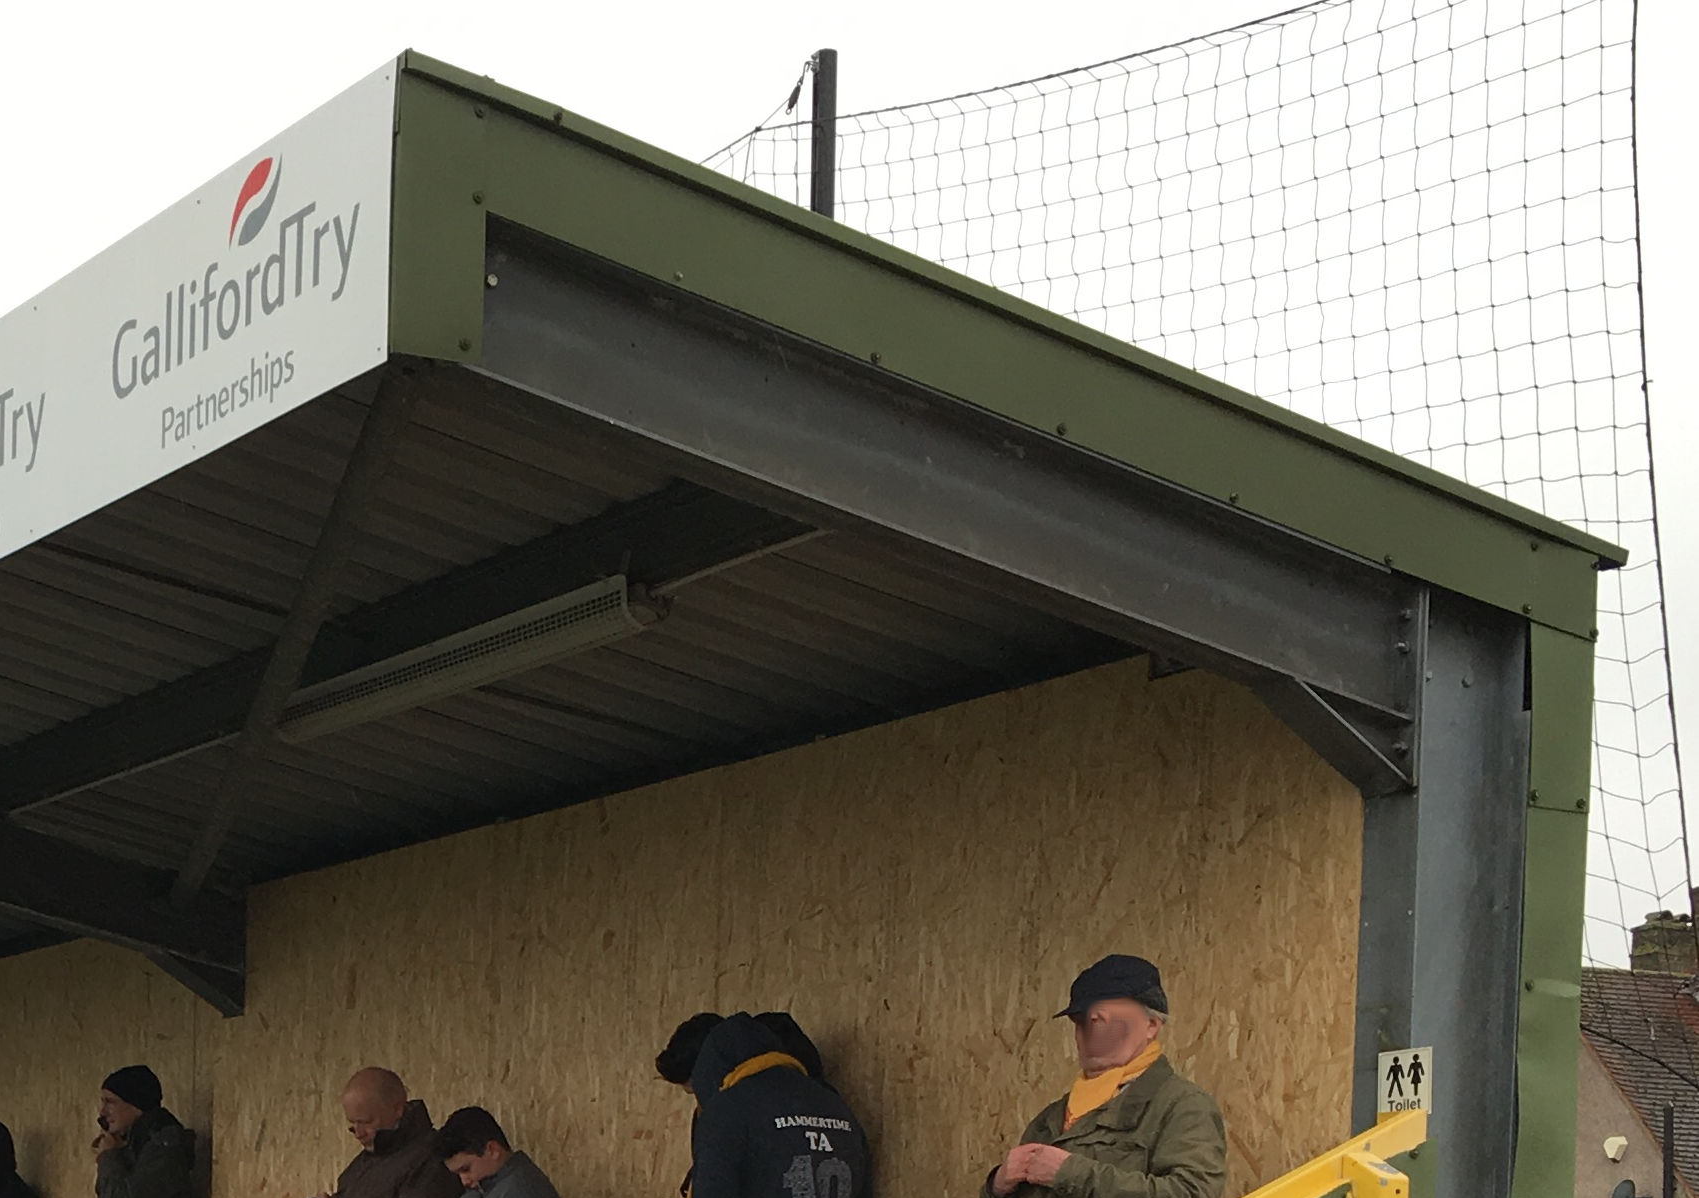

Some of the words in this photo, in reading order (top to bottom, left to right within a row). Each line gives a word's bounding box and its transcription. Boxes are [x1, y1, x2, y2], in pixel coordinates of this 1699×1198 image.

[111, 200, 361, 400] GallifordTry
[161, 350, 295, 450] Partnerships
[1387, 1098, 1421, 1112] Toilet
[774, 1115, 852, 1131] HAMMERTIME
[805, 1131, 833, 1152] TA
